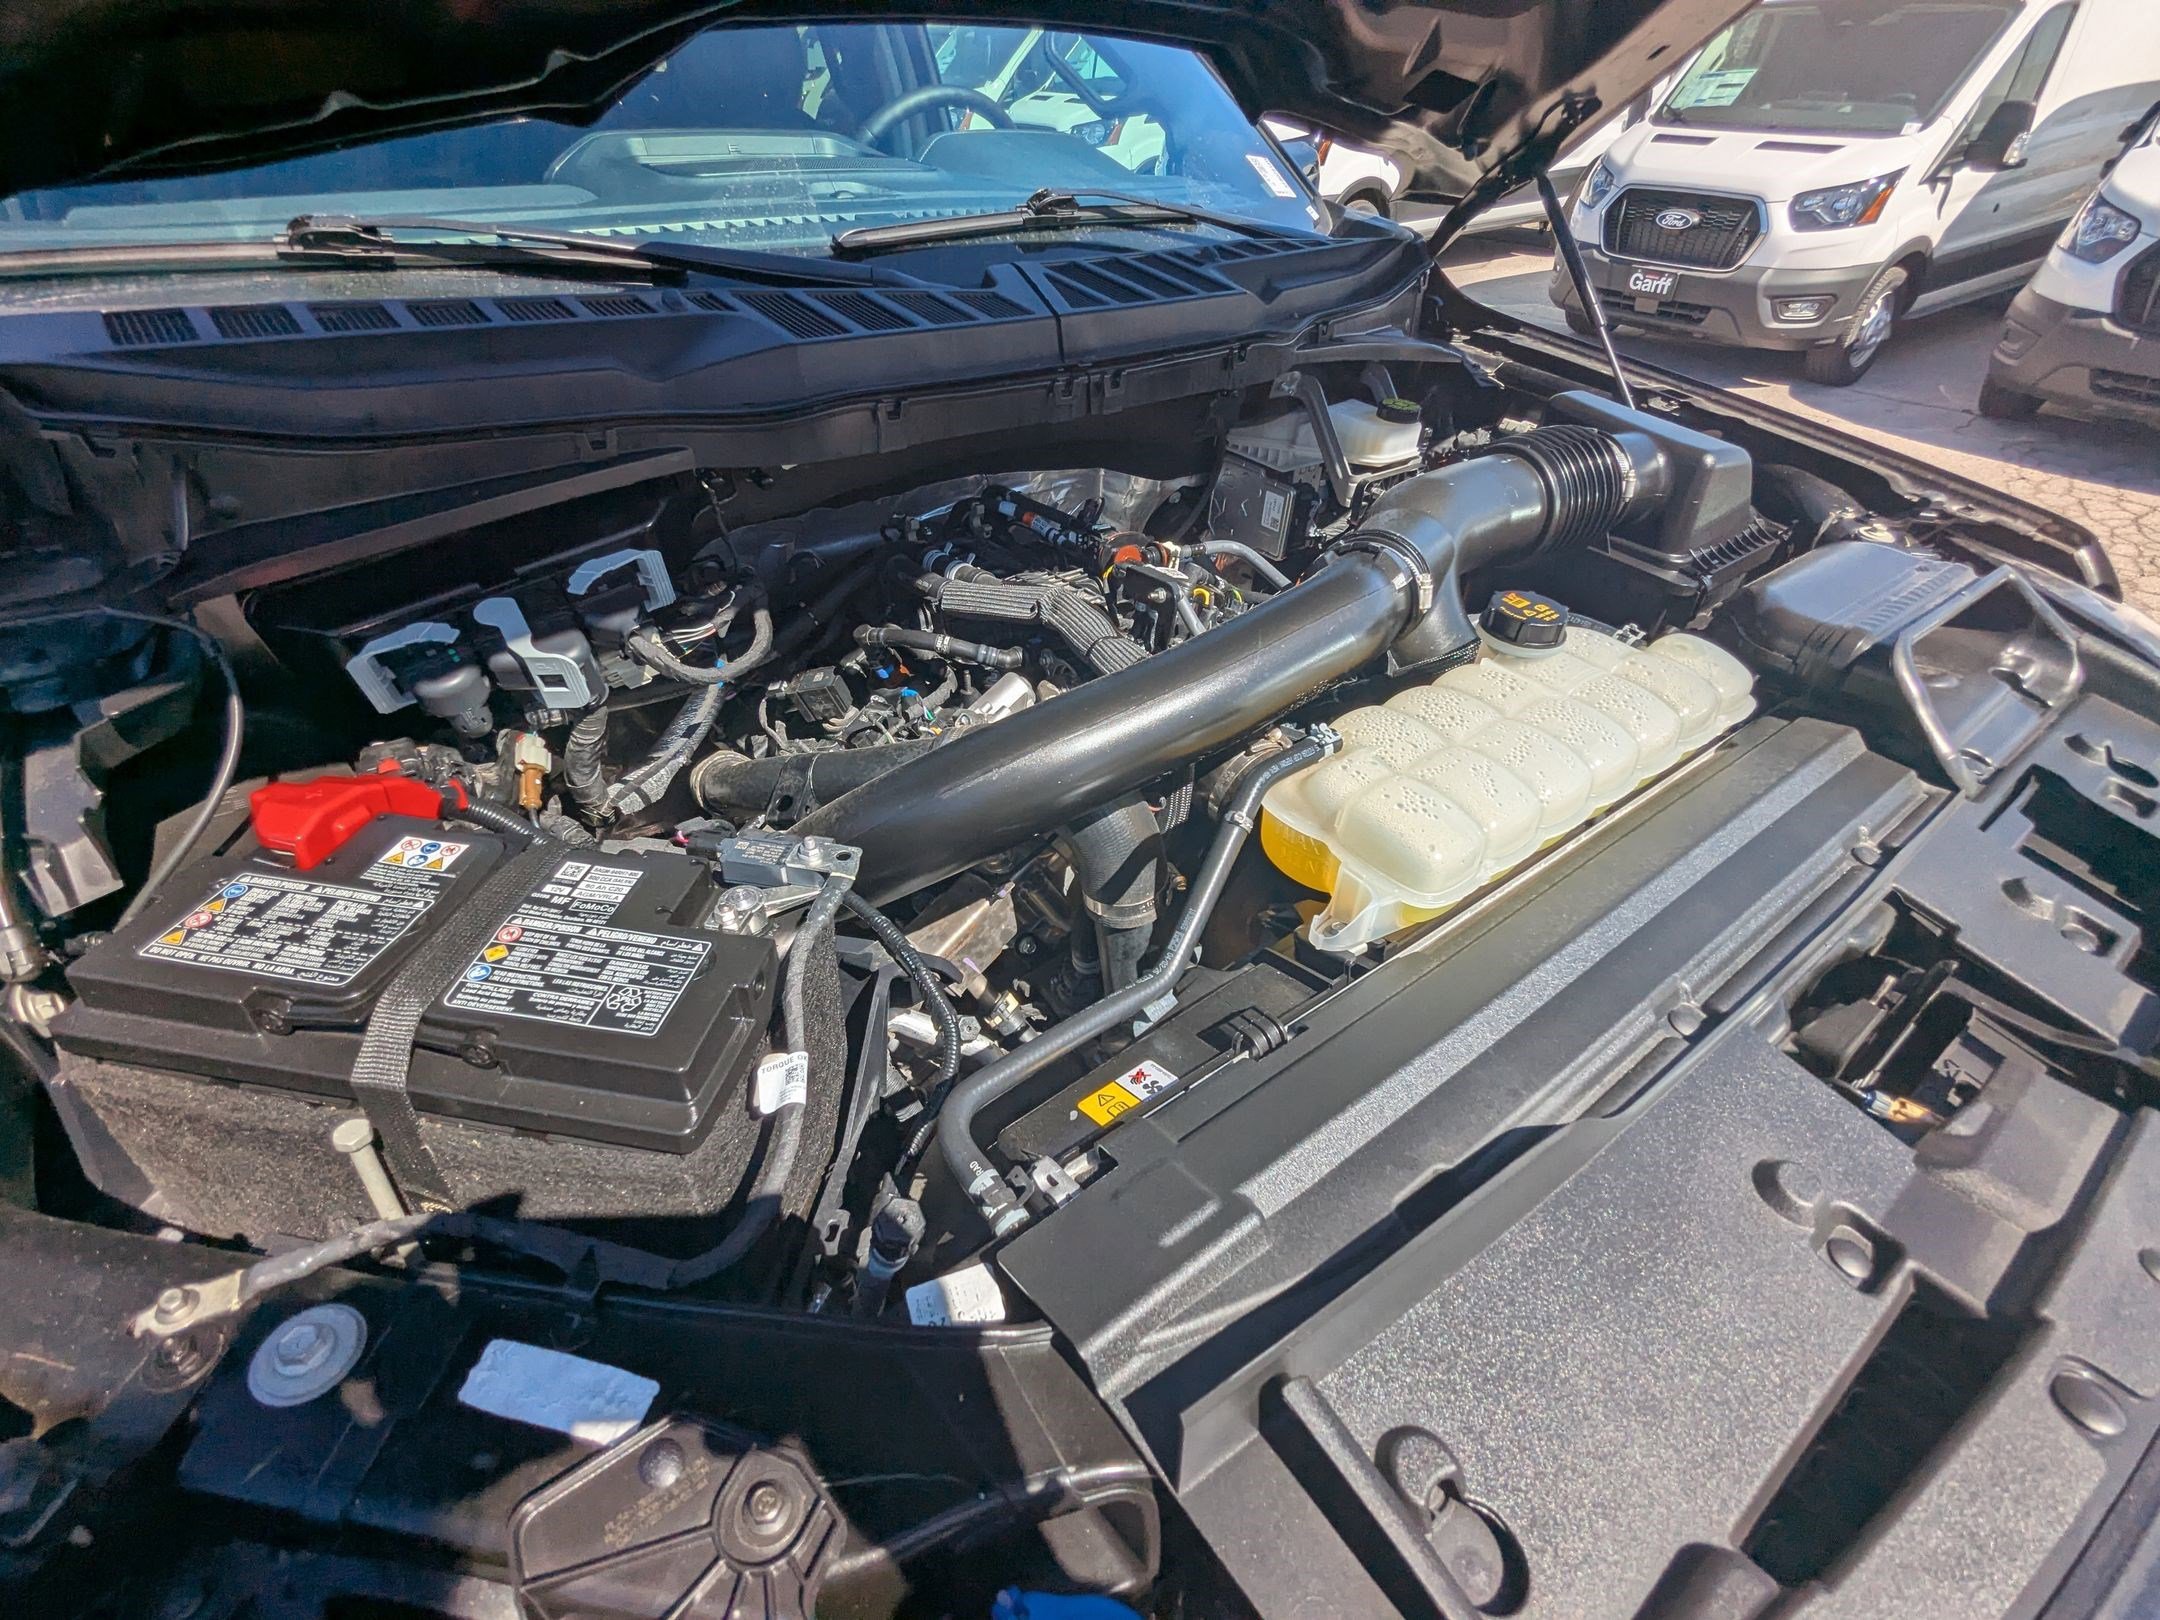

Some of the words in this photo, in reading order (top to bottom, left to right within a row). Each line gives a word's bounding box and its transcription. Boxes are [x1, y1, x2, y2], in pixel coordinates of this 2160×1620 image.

[1661, 214, 1686, 227] Ford
[1629, 272, 1673, 295] Garff
[550, 895, 573, 905] MF
[575, 891, 621, 901] AGM/VRLA
[571, 901, 616, 912] FoMoCo
[522, 919, 582, 932] DANGER/POISON
[597, 930, 657, 944] PELIGRO/VENENO
[761, 1056, 795, 1074] TORQUE
[969, 1160, 984, 1176] RAD
